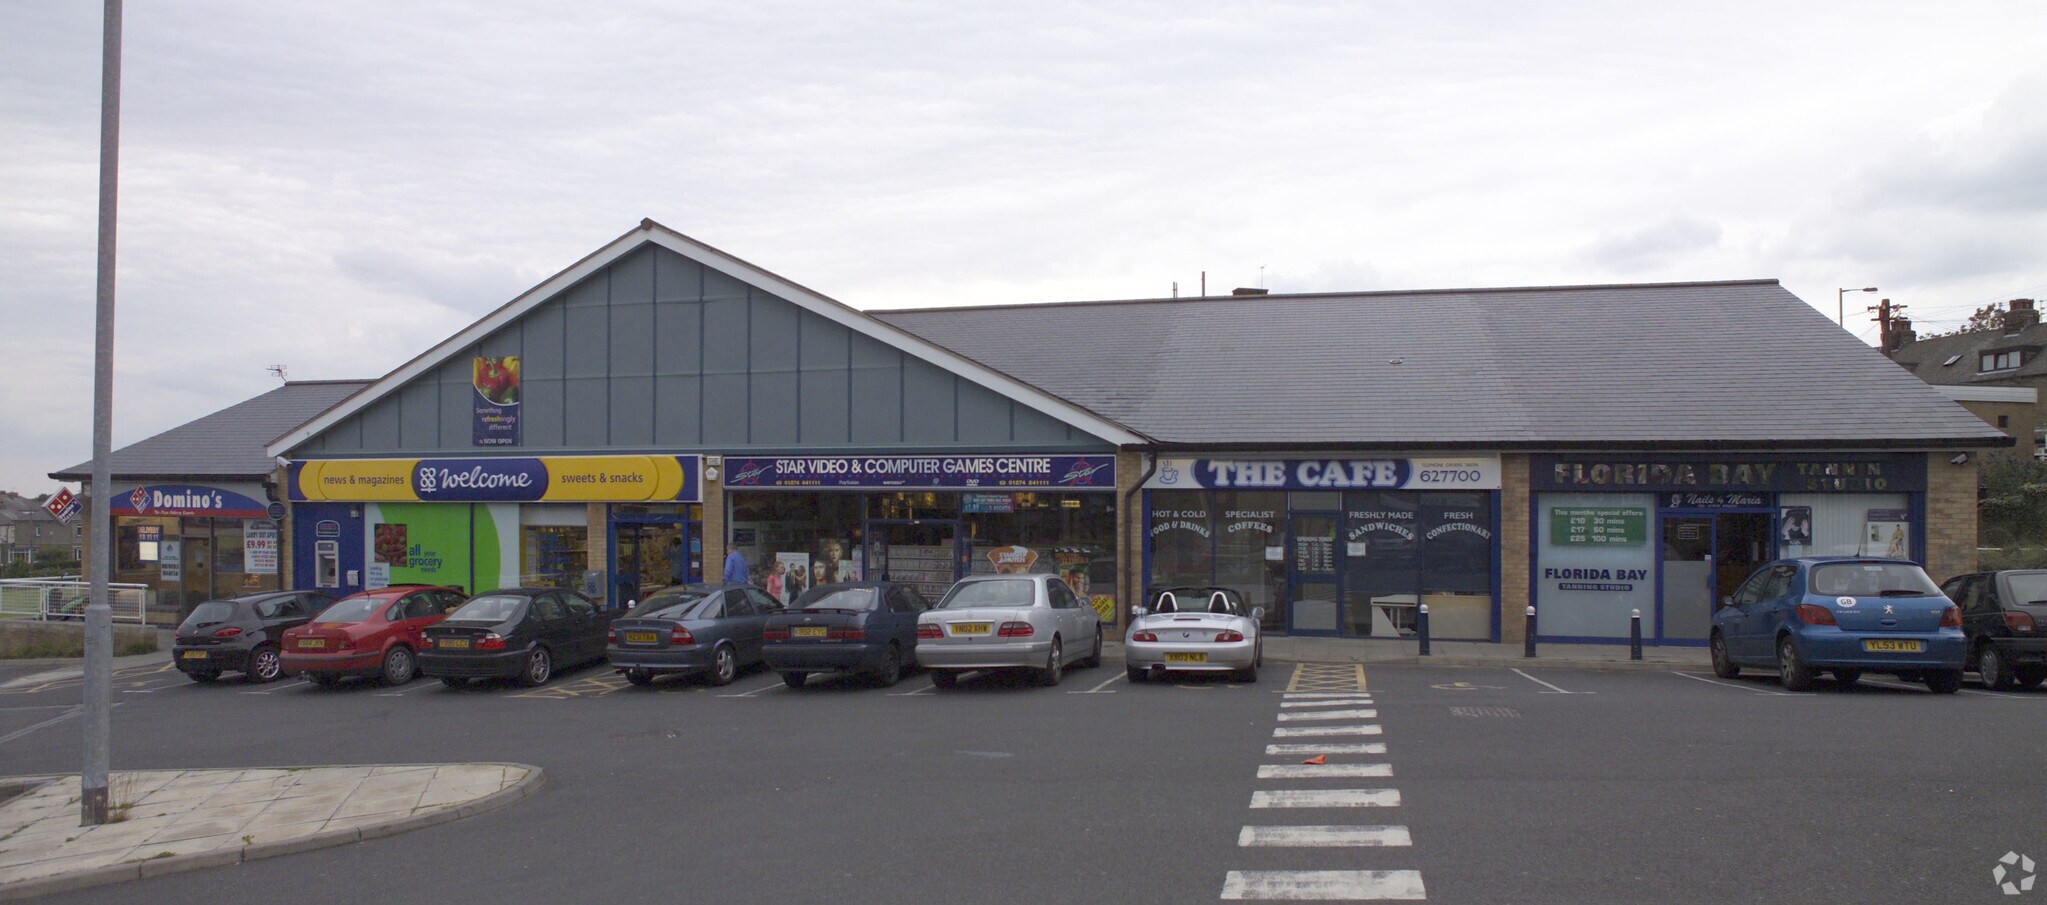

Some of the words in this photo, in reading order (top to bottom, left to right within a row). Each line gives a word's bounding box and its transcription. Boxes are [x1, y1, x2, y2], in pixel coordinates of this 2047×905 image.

[776, 459, 805, 474] STAR
[808, 459, 848, 474] VIDEO
[852, 459, 862, 474] &
[865, 458, 940, 474] COMPUTER
[943, 458, 994, 473] GAMES
[996, 458, 1050, 473] CENTRE
[441, 466, 533, 488] welcome
[561, 473, 596, 483] sweets
[600, 473, 607, 483] &
[610, 472, 643, 483] snacks
[1207, 460, 1287, 486] THE
[1420, 470, 1481, 482] 627700
[1555, 463, 1696, 484] FLORIDA
[1709, 463, 1776, 485] BAY
[324, 476, 347, 484] news
[349, 475, 356, 484] &
[358, 475, 404, 487] magazines
[153, 489, 222, 509] Domino's
[1686, 493, 1715, 504] Nails
[1727, 493, 1763, 505] Maria
[1152, 510, 1171, 518] HOT
[1173, 510, 1179, 518] &
[1181, 510, 1206, 518] COLD
[1225, 510, 1275, 518] SPECIALIST
[1180, 521, 1211, 538] DRINKS
[1227, 521, 1273, 534] COFFEES
[1349, 522, 1415, 541] SANDWICHES
[409, 544, 420, 556] all
[409, 557, 442, 568] grocery
[1545, 568, 1611, 580] FLORIDA
[1616, 569, 1648, 581] BAY
[955, 624, 972, 633] YN02
[974, 624, 987, 633] XHW
[1870, 641, 1895, 650] YL53
